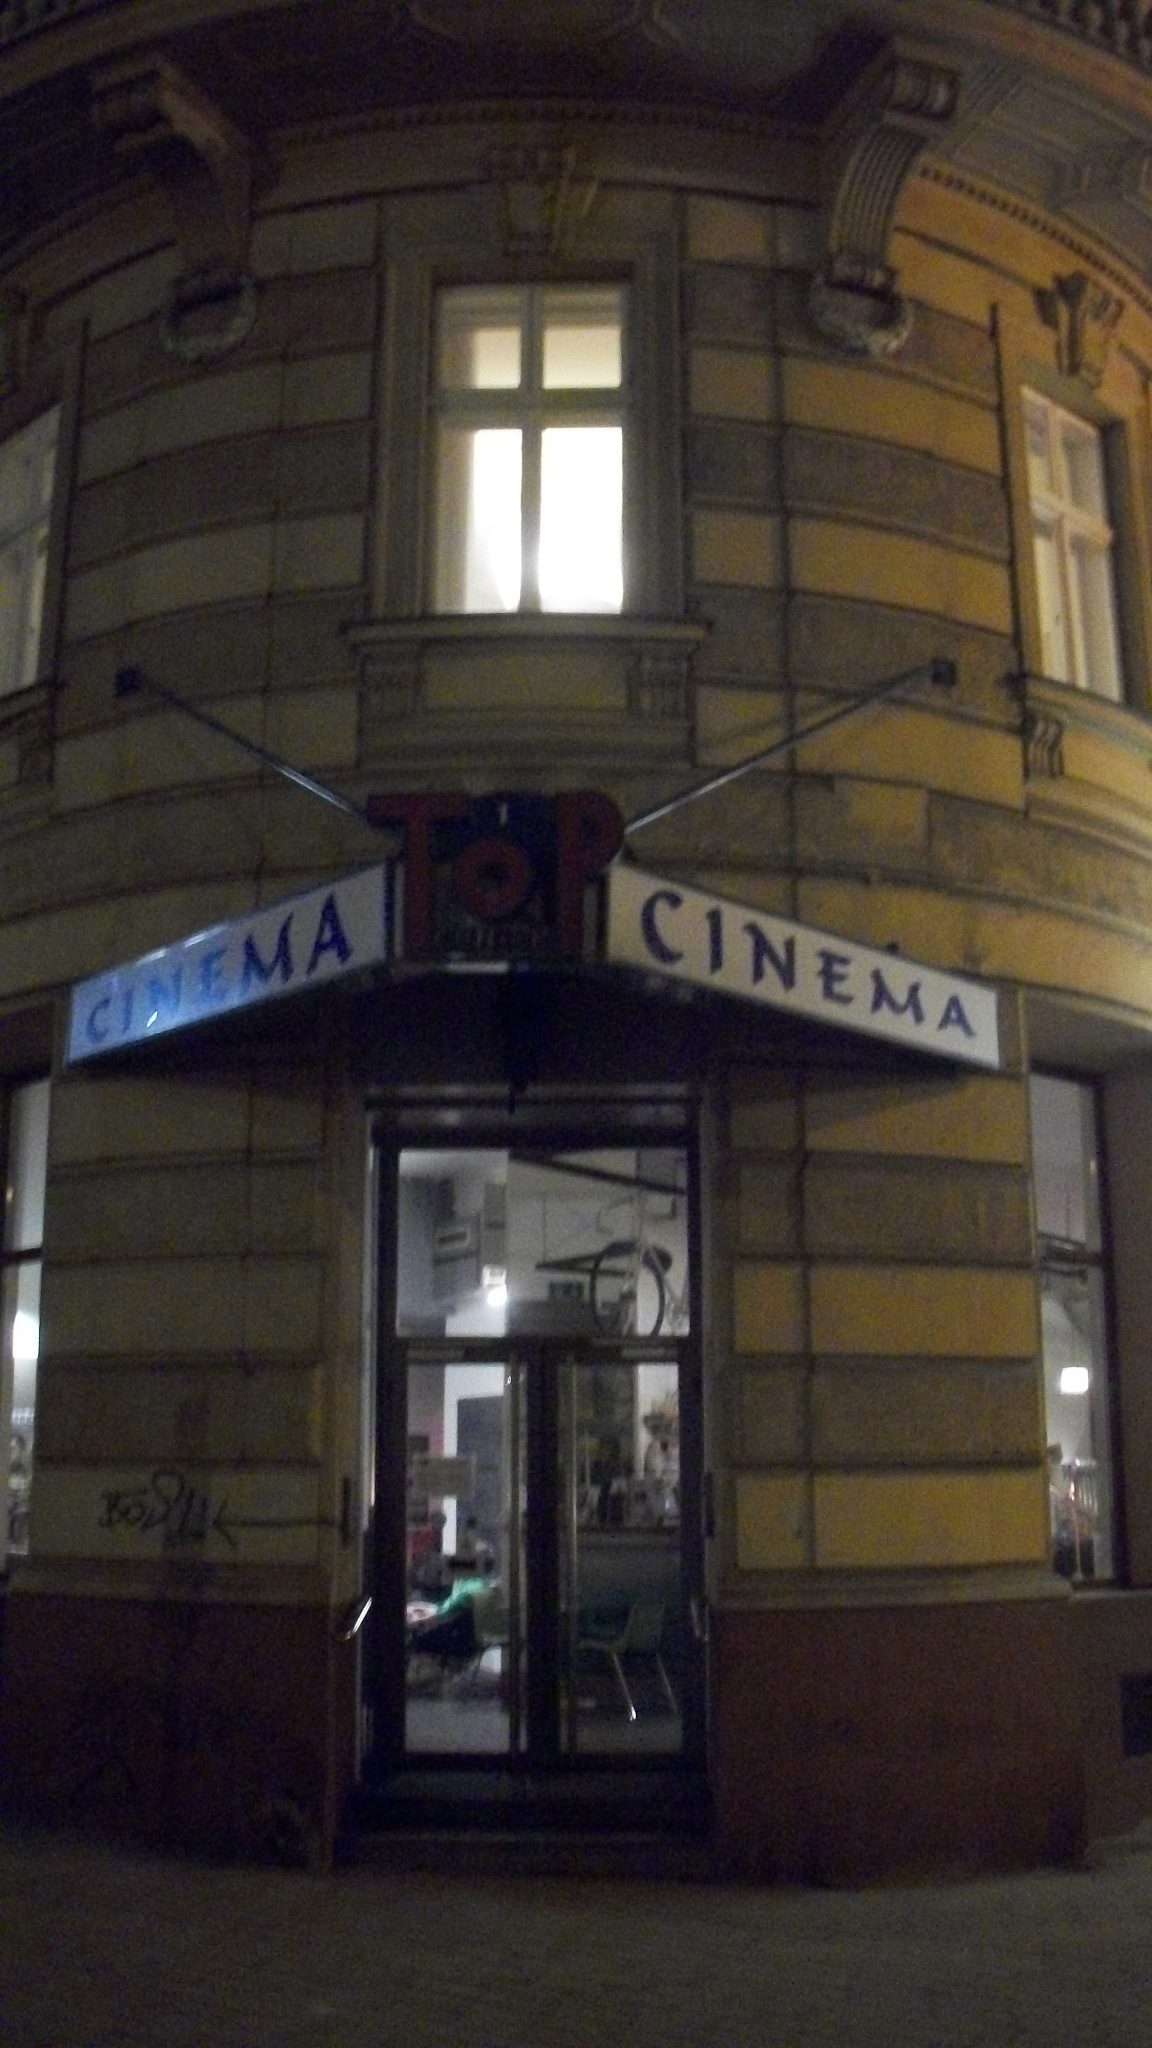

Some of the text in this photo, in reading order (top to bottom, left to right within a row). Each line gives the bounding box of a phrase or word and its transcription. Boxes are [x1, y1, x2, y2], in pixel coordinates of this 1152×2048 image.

[367, 791, 625, 957] TOP
[85, 892, 351, 1045] CINEMA
[640, 889, 976, 1038] CINEMA
